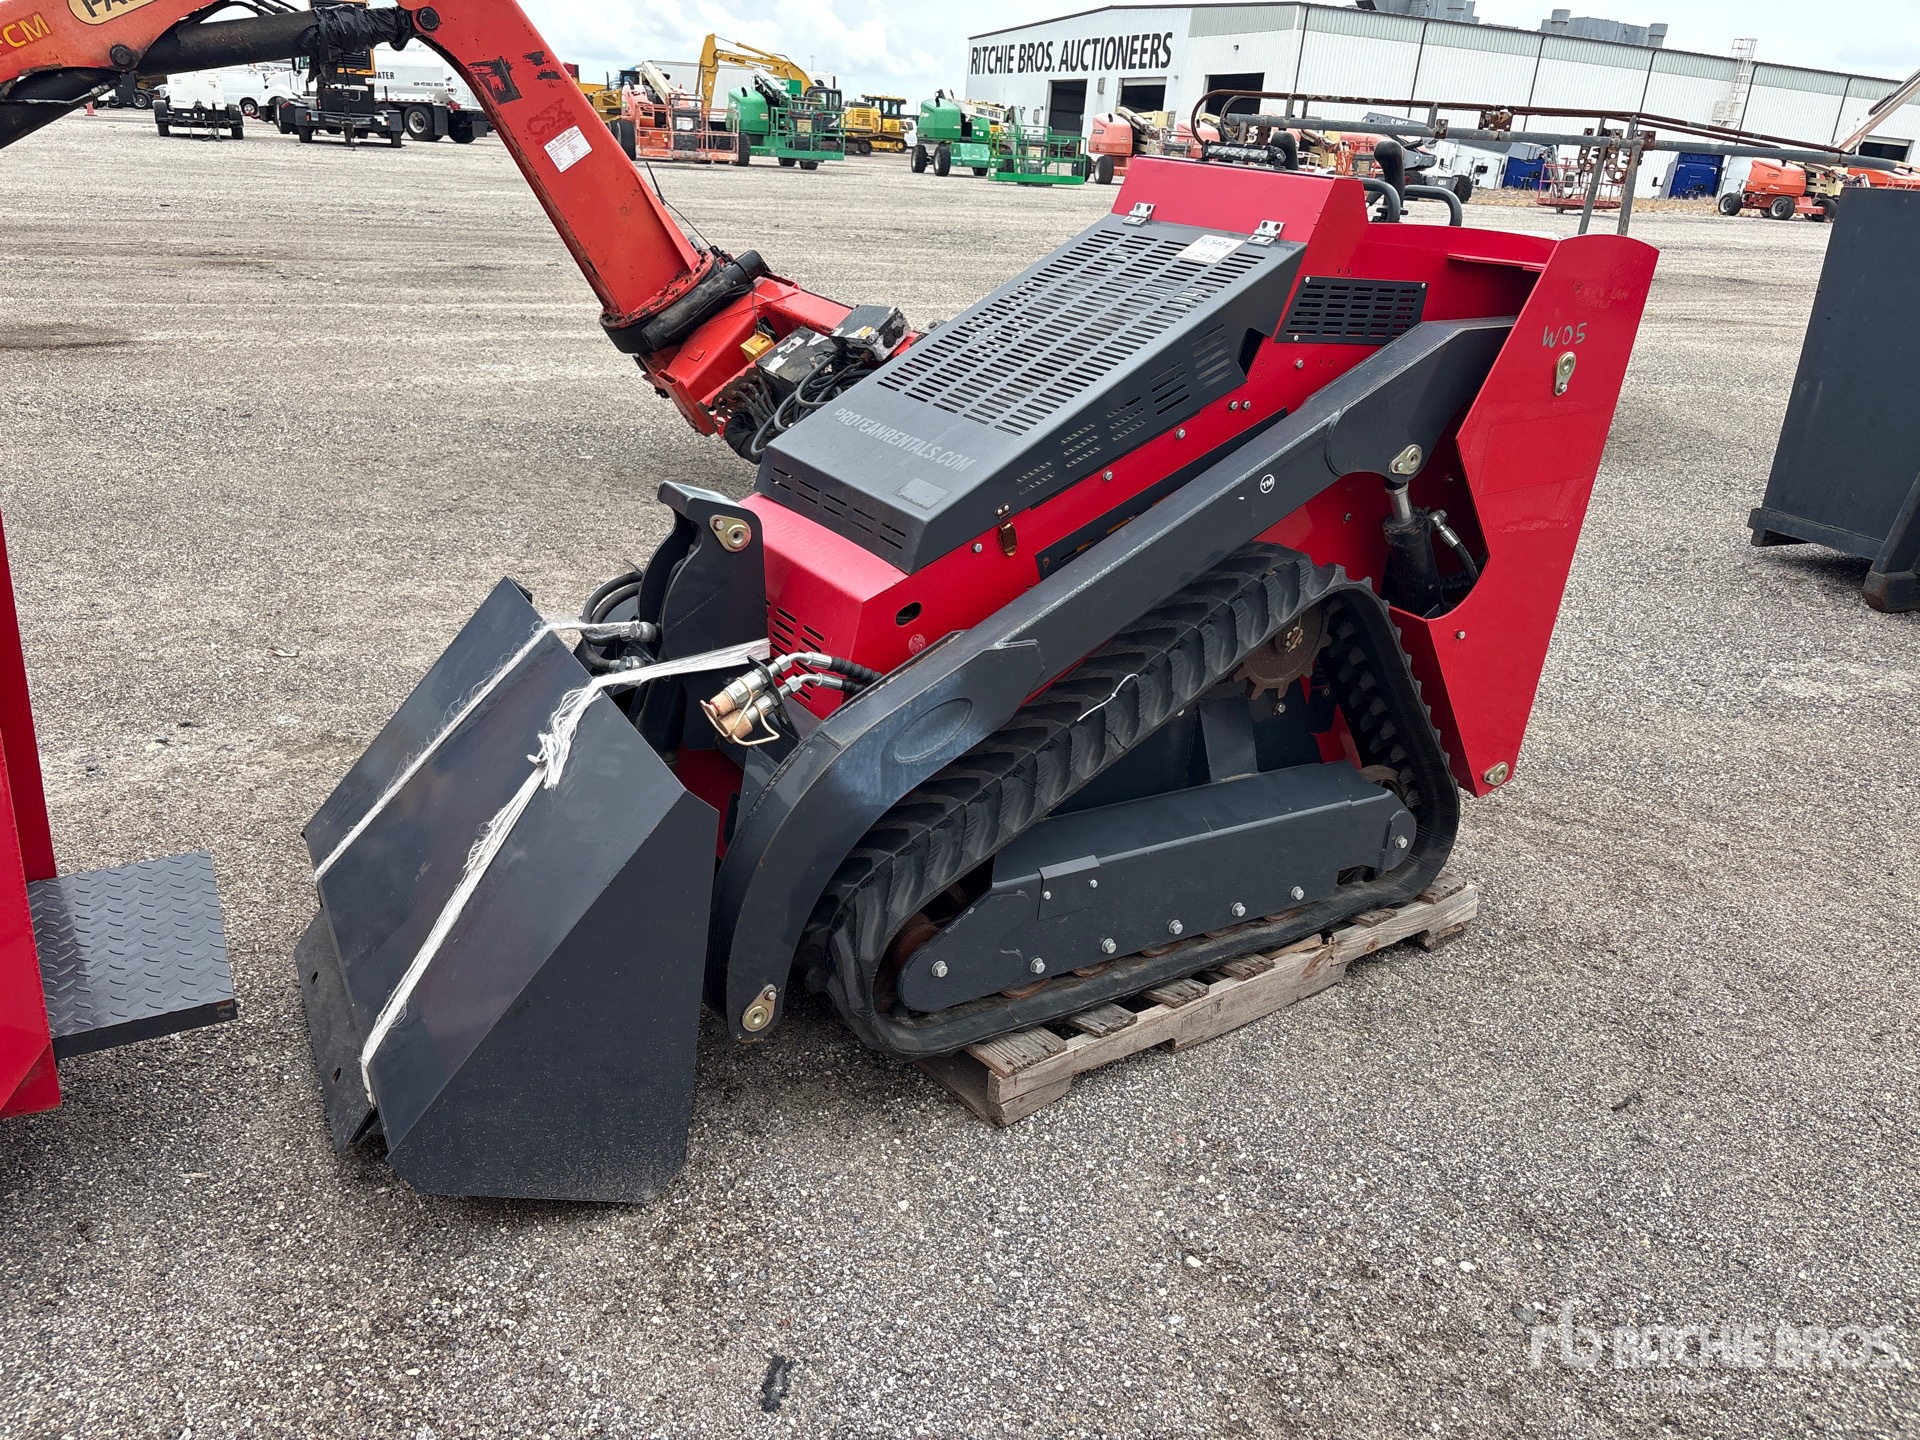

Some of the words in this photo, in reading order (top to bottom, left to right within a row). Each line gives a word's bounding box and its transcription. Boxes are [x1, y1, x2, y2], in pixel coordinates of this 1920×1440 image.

[0, 13, 51, 54] CM
[970, 44, 1016, 75] RITCHIE
[1017, 40, 1055, 74] BROS.
[1058, 31, 1174, 73] AUCTIONEERS
[374, 71, 395, 80] ATER
[833, 407, 977, 473] PROTEANRENTALS.COM
[1261, 477, 1273, 489] TM
